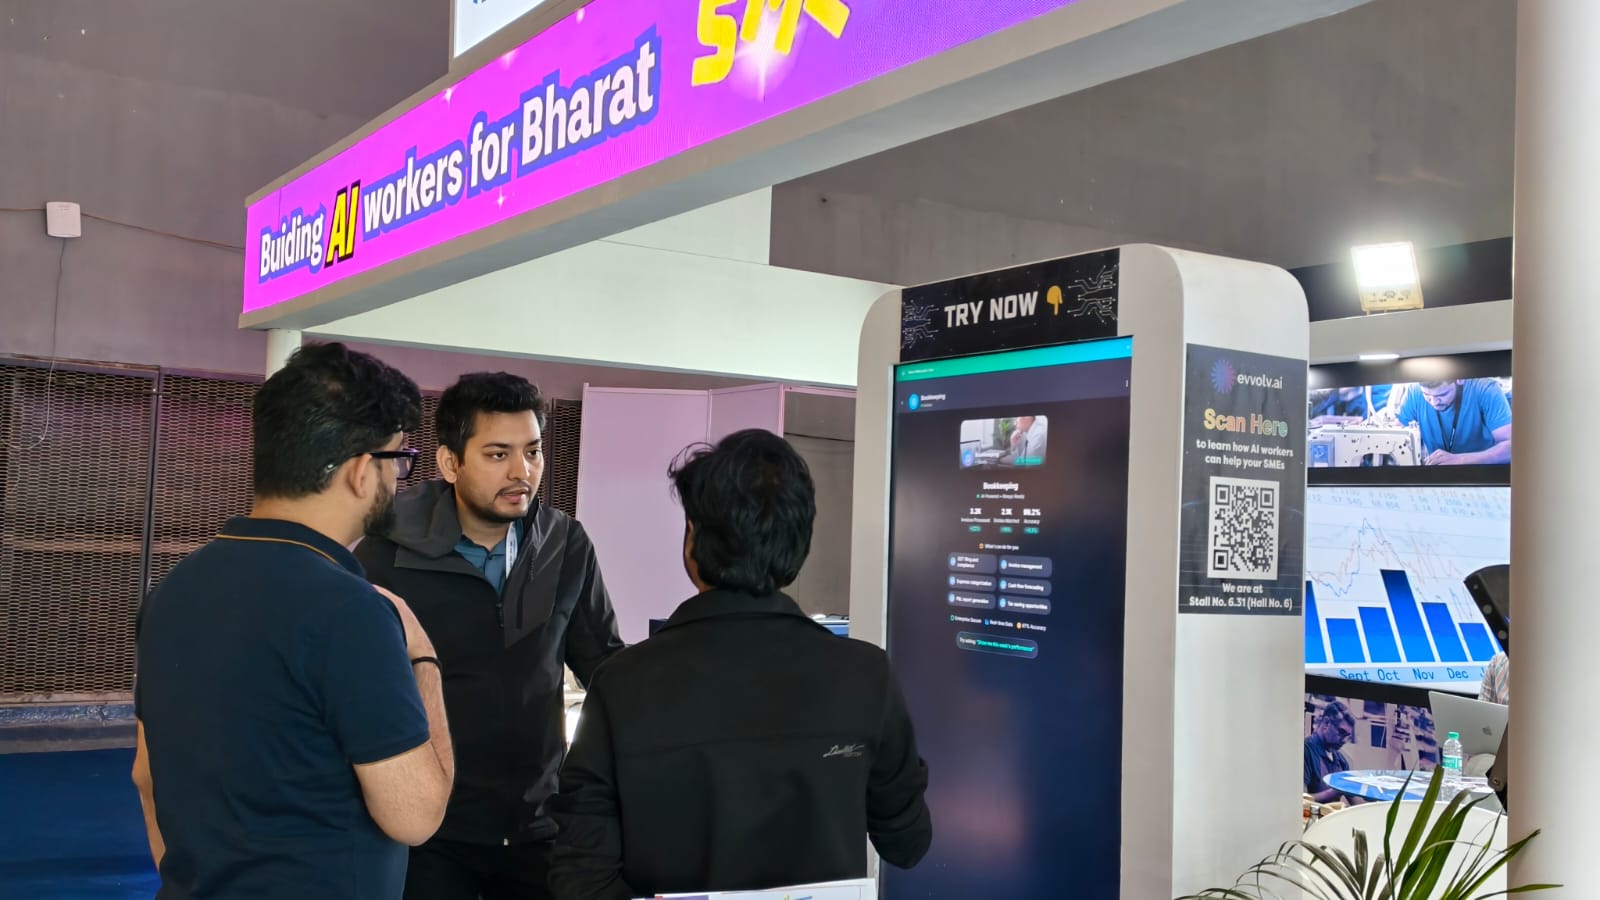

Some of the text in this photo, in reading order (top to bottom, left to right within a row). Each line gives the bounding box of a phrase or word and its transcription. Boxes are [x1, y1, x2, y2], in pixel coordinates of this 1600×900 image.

[260, 40, 656, 277] Buiding AI workers for Bharat
[944, 291, 1038, 328] TRY NOW
[1237, 374, 1283, 389] evvolv.ai
[1203, 408, 1288, 438] Scan Here
[1196, 439, 1294, 457] to learn how AI workers
[1205, 455, 1285, 470] can help your SMEs
[1222, 582, 1263, 594] We are at
[1189, 596, 1293, 611] Stall No. 6.31 (Hall No. 6)
[1339, 669, 1371, 681] Sept
[1377, 669, 1400, 681] Oct
[1412, 668, 1435, 681] Nov
[1446, 667, 1469, 680] Dec
